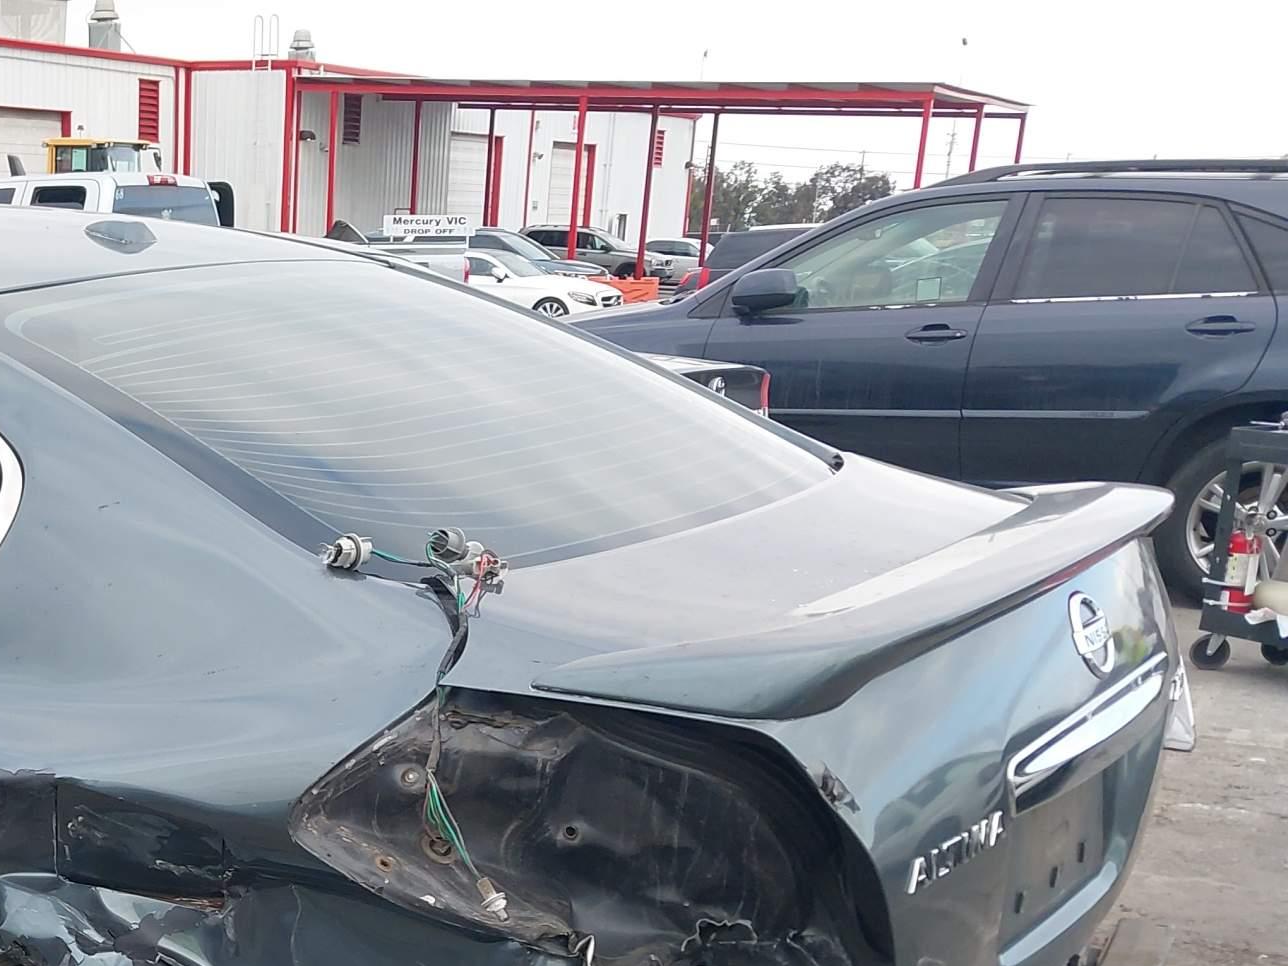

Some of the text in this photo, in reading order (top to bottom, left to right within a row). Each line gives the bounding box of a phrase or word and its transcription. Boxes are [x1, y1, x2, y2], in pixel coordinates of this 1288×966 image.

[393, 216, 467, 226] Mercury VIC
[906, 810, 1006, 894] ALTIMA
